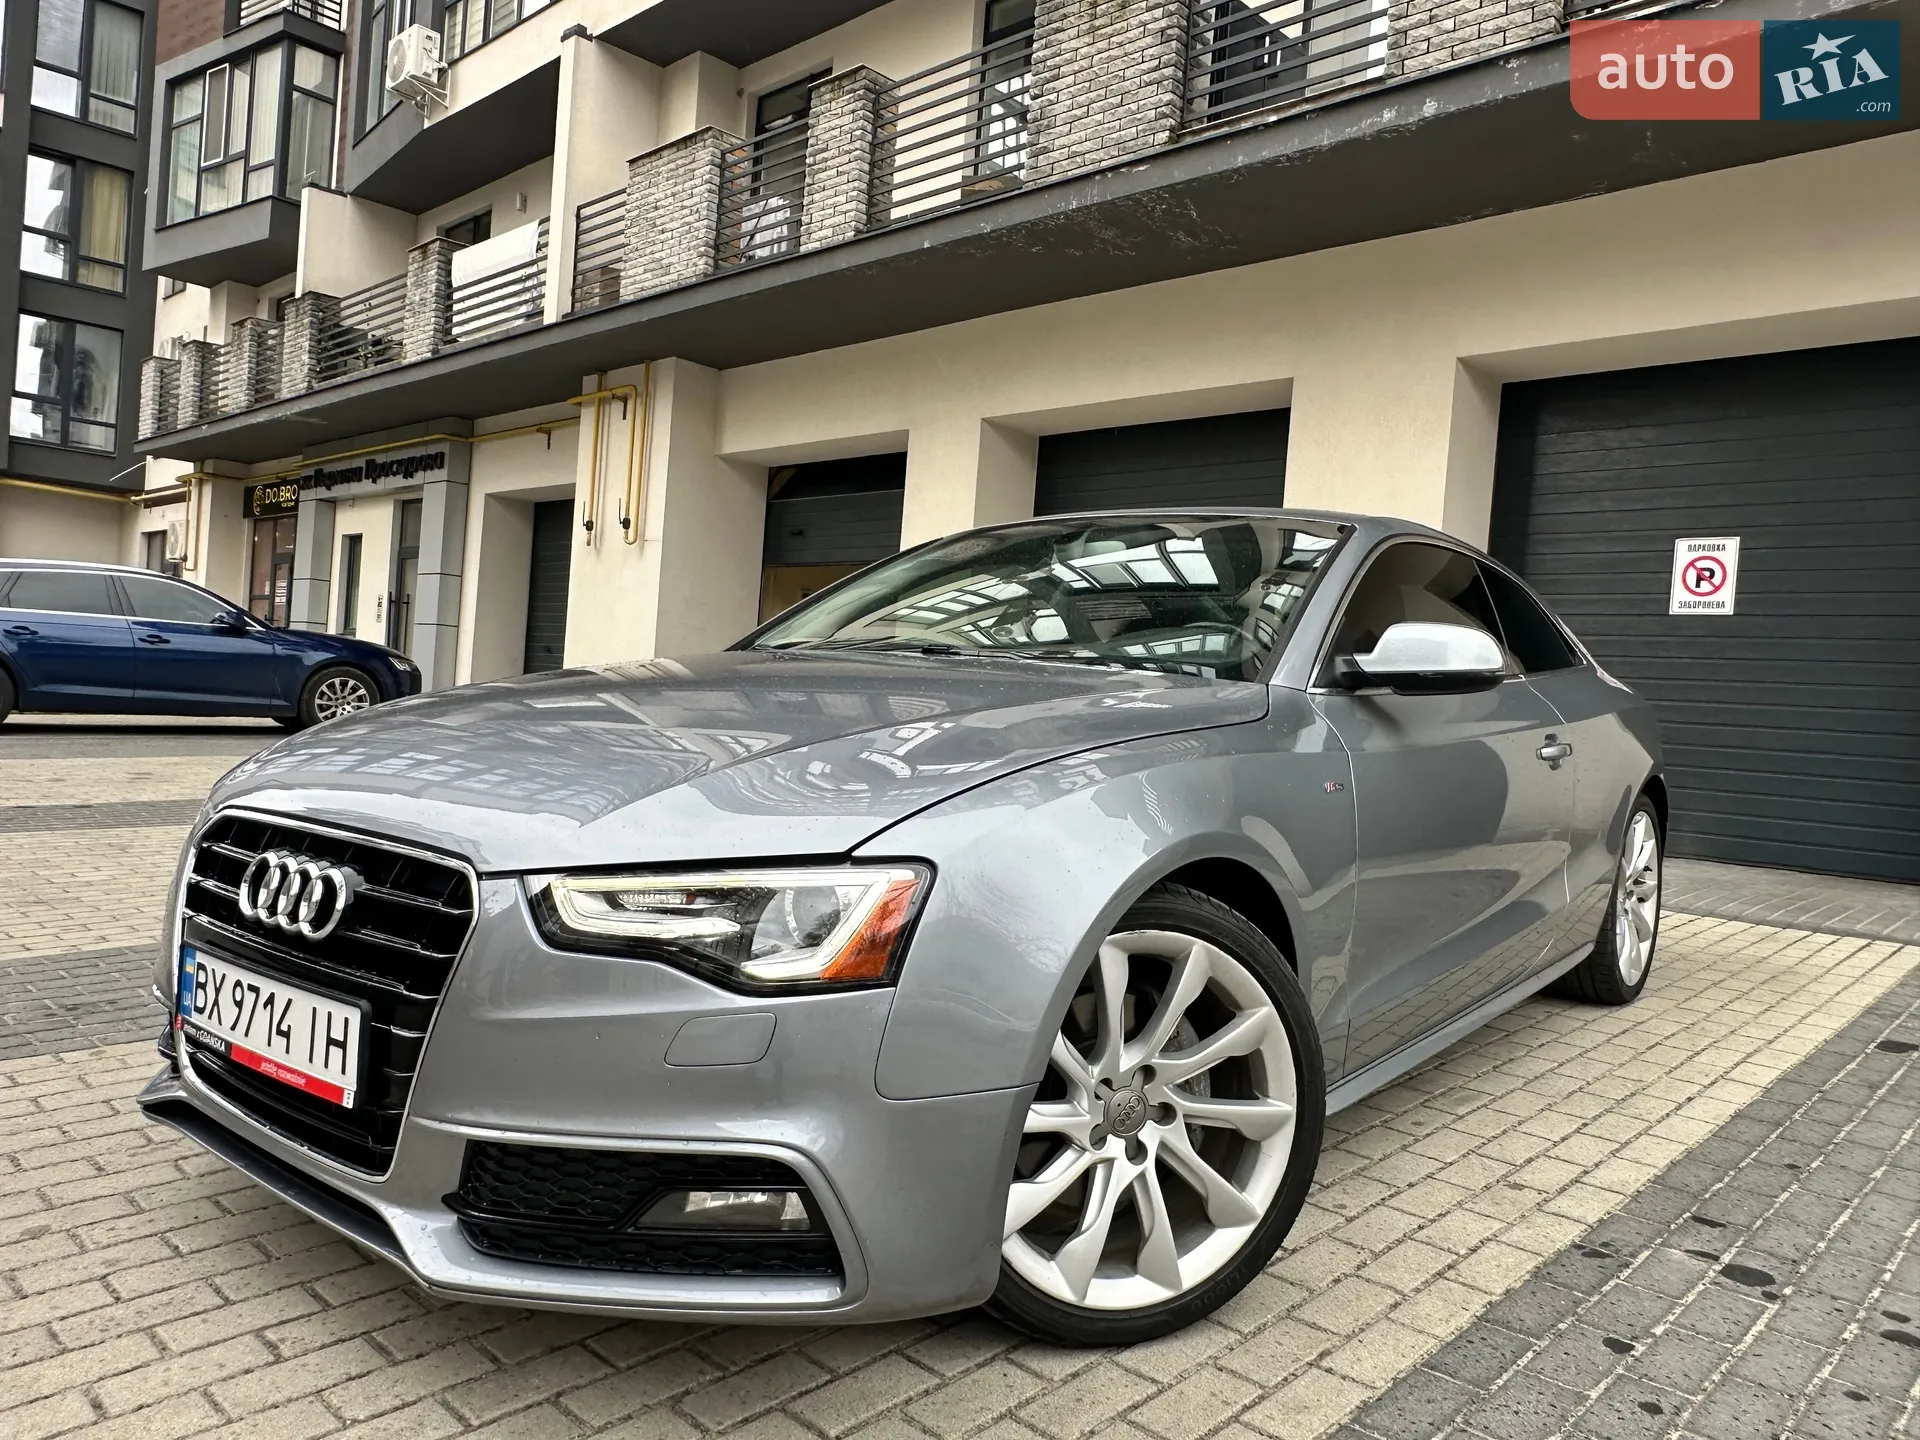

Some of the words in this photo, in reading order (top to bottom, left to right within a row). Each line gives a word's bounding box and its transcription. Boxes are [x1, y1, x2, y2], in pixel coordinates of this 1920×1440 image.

[183, 990, 192, 1008] UA
[193, 961, 227, 1026] BX
[229, 978, 294, 1055] 9714
[308, 1006, 350, 1076] IH
